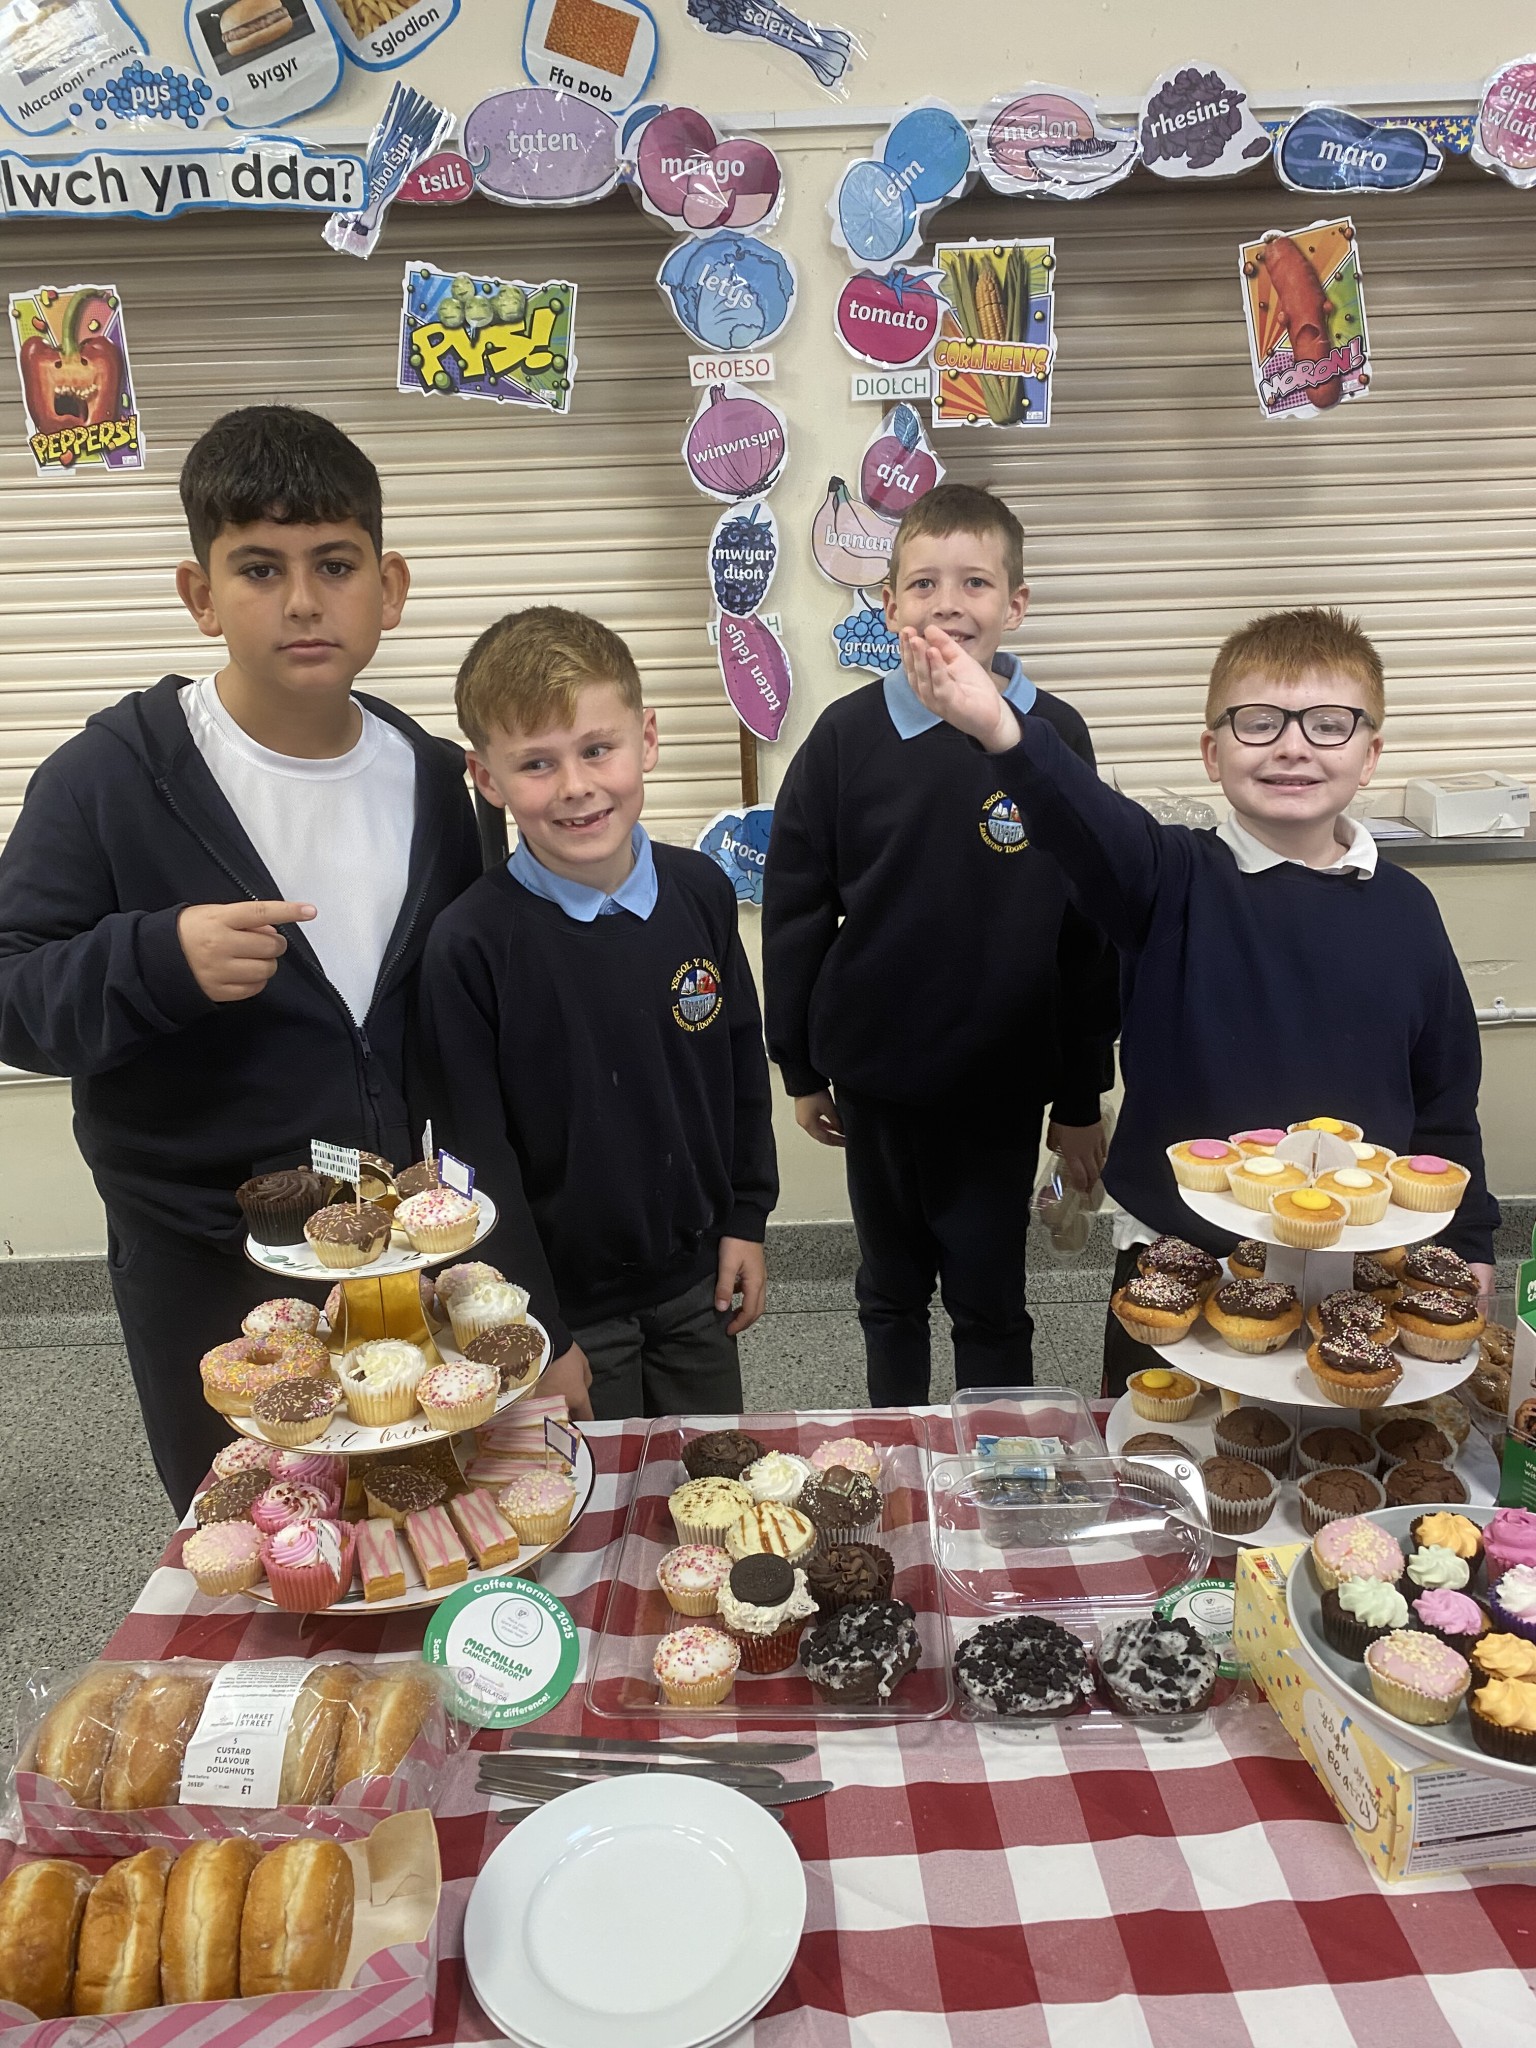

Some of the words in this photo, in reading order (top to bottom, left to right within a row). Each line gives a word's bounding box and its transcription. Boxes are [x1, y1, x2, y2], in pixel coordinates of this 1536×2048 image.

[370, 8, 441, 58] Sglodion
[742, 7, 797, 41] seleri
[247, 55, 299, 91] Byrgyr
[549, 65, 574, 90] Ffa
[577, 77, 613, 103] pob
[18, 72, 85, 119] Macaroni
[131, 84, 171, 110] pys
[1003, 117, 1079, 144] melon
[1149, 94, 1231, 138] rhesins
[1488, 108, 1536, 141] wlan
[506, 129, 580, 154] taten
[1318, 138, 1388, 172] maro
[140, 159, 211, 213] yn
[231, 152, 356, 203] dda?
[418, 163, 466, 195] tsili
[660, 154, 745, 184] mango
[875, 158, 925, 208] leim
[698, 263, 755, 309] letys
[849, 300, 928, 332] tomato
[411, 308, 557, 387] PYS!
[934, 340, 986, 371] CORN
[985, 344, 1050, 375] MELYS
[693, 358, 770, 379] CROESO
[1260, 337, 1364, 403] MORON!
[856, 377, 928, 396] DIOLCH
[30, 415, 137, 464] PEPPERS!
[692, 426, 781, 464] winwnsyn
[876, 461, 919, 494] afal
[715, 547, 774, 564] mwyar
[825, 525, 892, 552] banan
[724, 564, 764, 580] duon
[725, 623, 758, 666] felys
[751, 666, 781, 711] taten
[982, 790, 1007, 811] YSGO
[720, 831, 767, 866] broco
[1004, 839, 1030, 854] TOGET
[473, 1579, 513, 1594] Coffee
[516, 1581, 558, 1612] Morning
[556, 1612, 574, 1640] 2025
[462, 1647, 491, 1666] CANCER
[491, 1661, 525, 1682] SUPPORT
[464, 1637, 533, 1677] MACMILLAN
[503, 1693, 551, 1718] difference!
[214, 1756, 250, 1765] FLAVOUR
[216, 1746, 251, 1755] CUSTARD
[206, 1766, 255, 1775] DOUGHNUTS
[241, 1785, 252, 1795] £1
